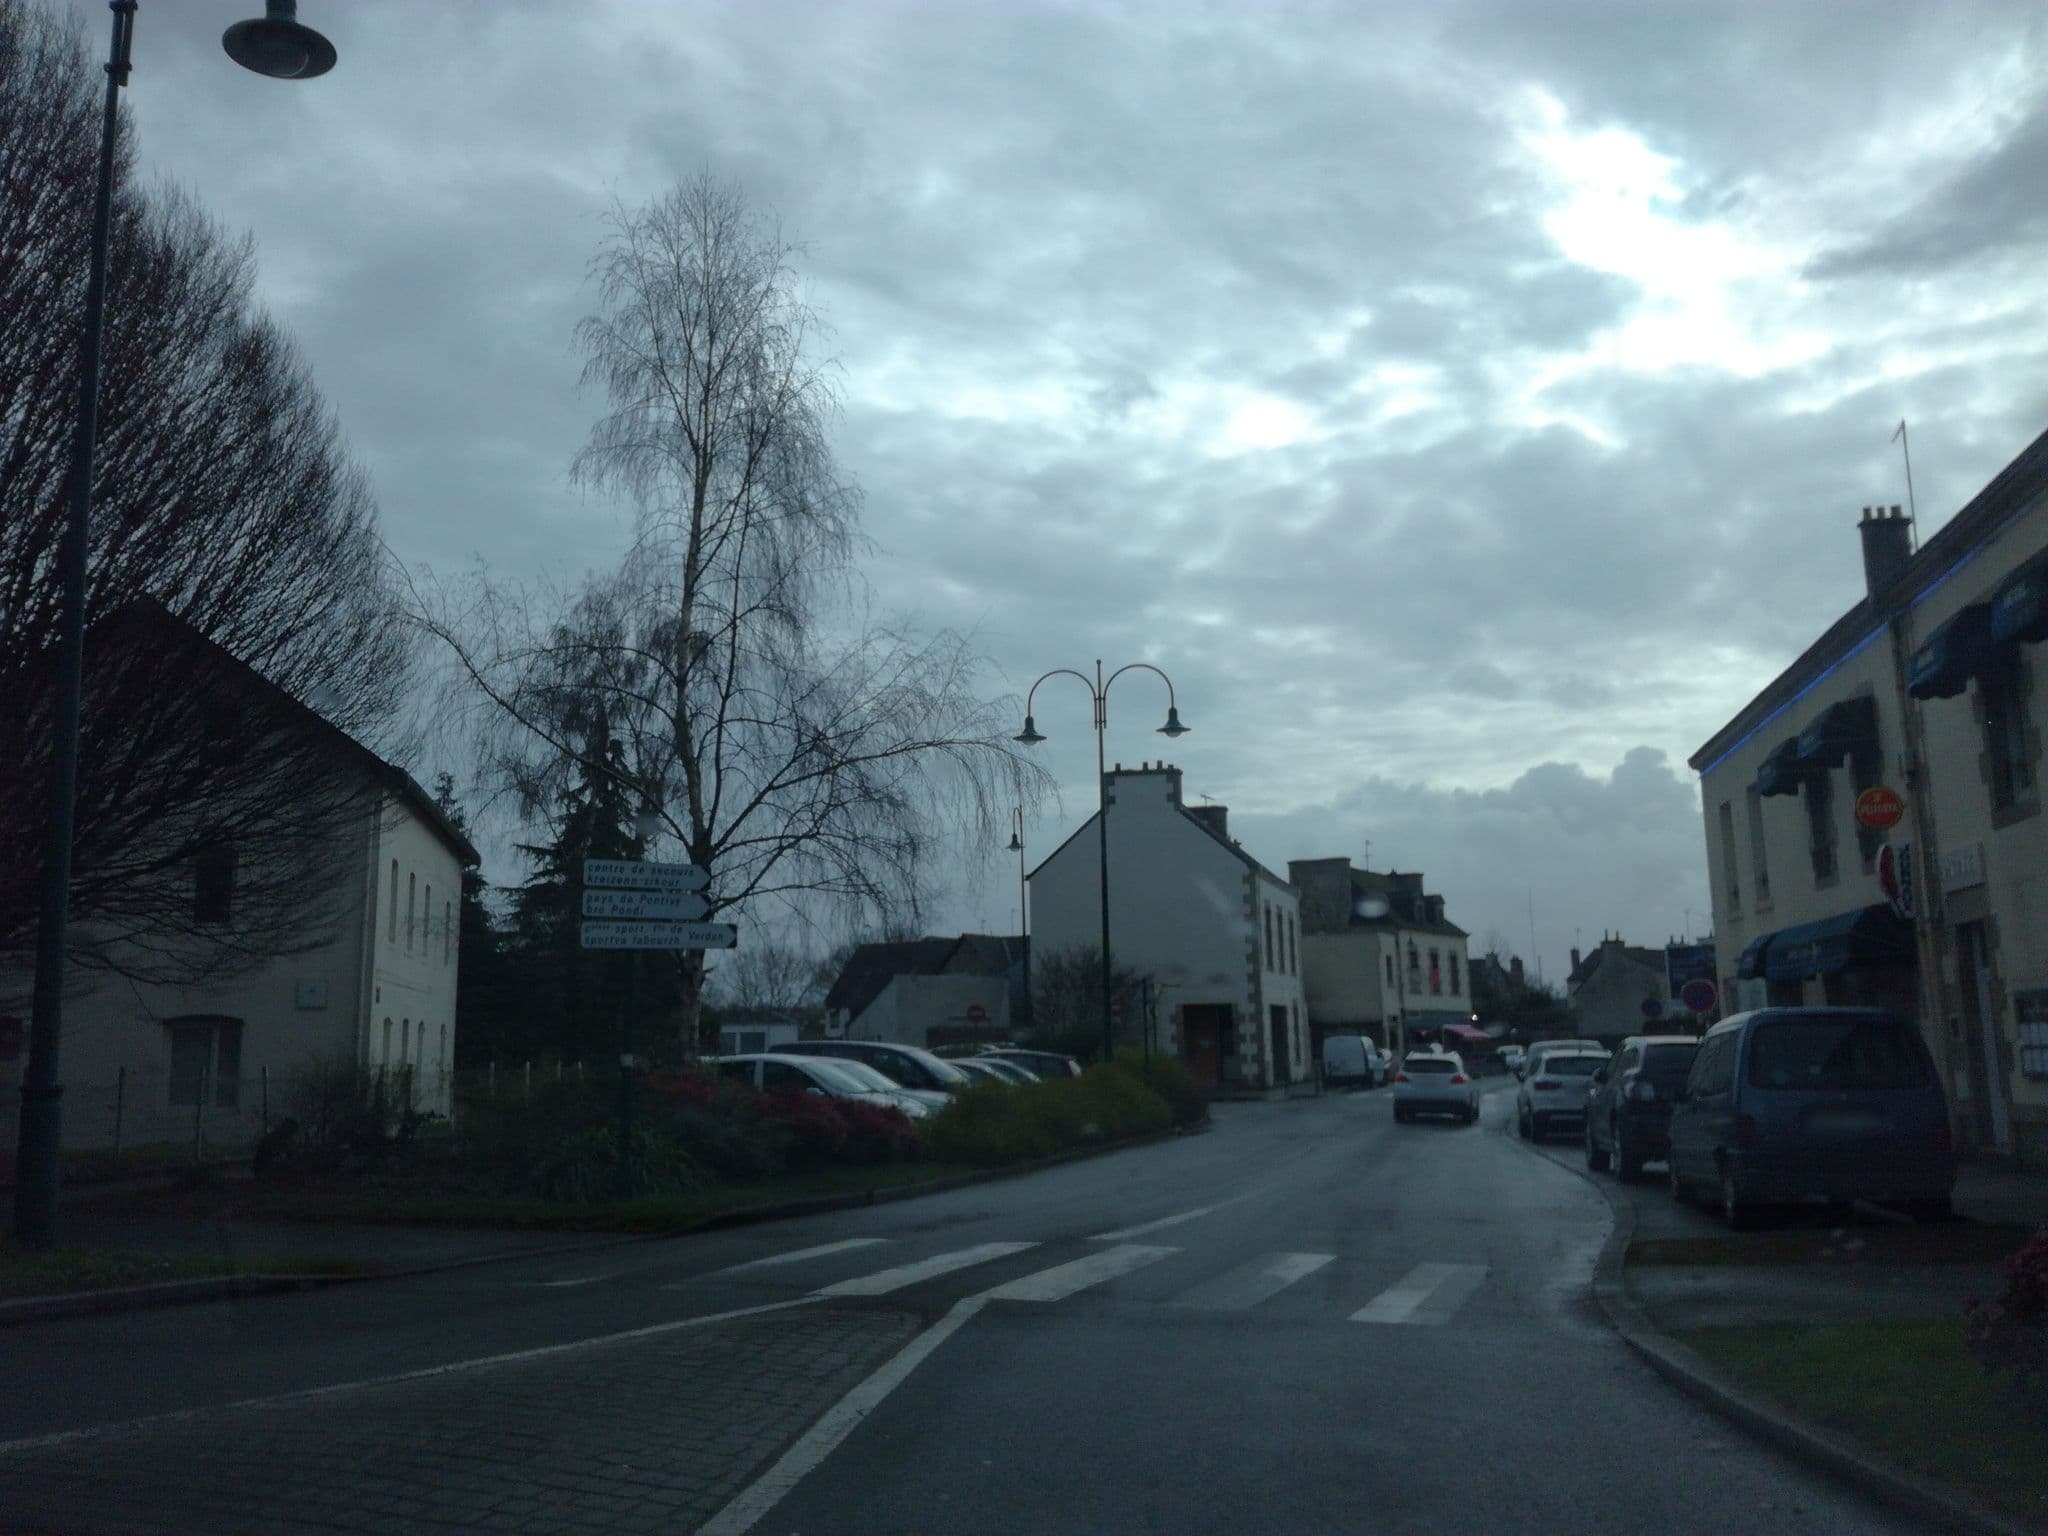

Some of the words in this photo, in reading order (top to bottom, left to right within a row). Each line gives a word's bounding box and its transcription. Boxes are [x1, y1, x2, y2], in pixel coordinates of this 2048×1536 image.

[632, 864, 645, 874] de
[620, 894, 633, 903] de
[640, 894, 681, 906] Pontivy
